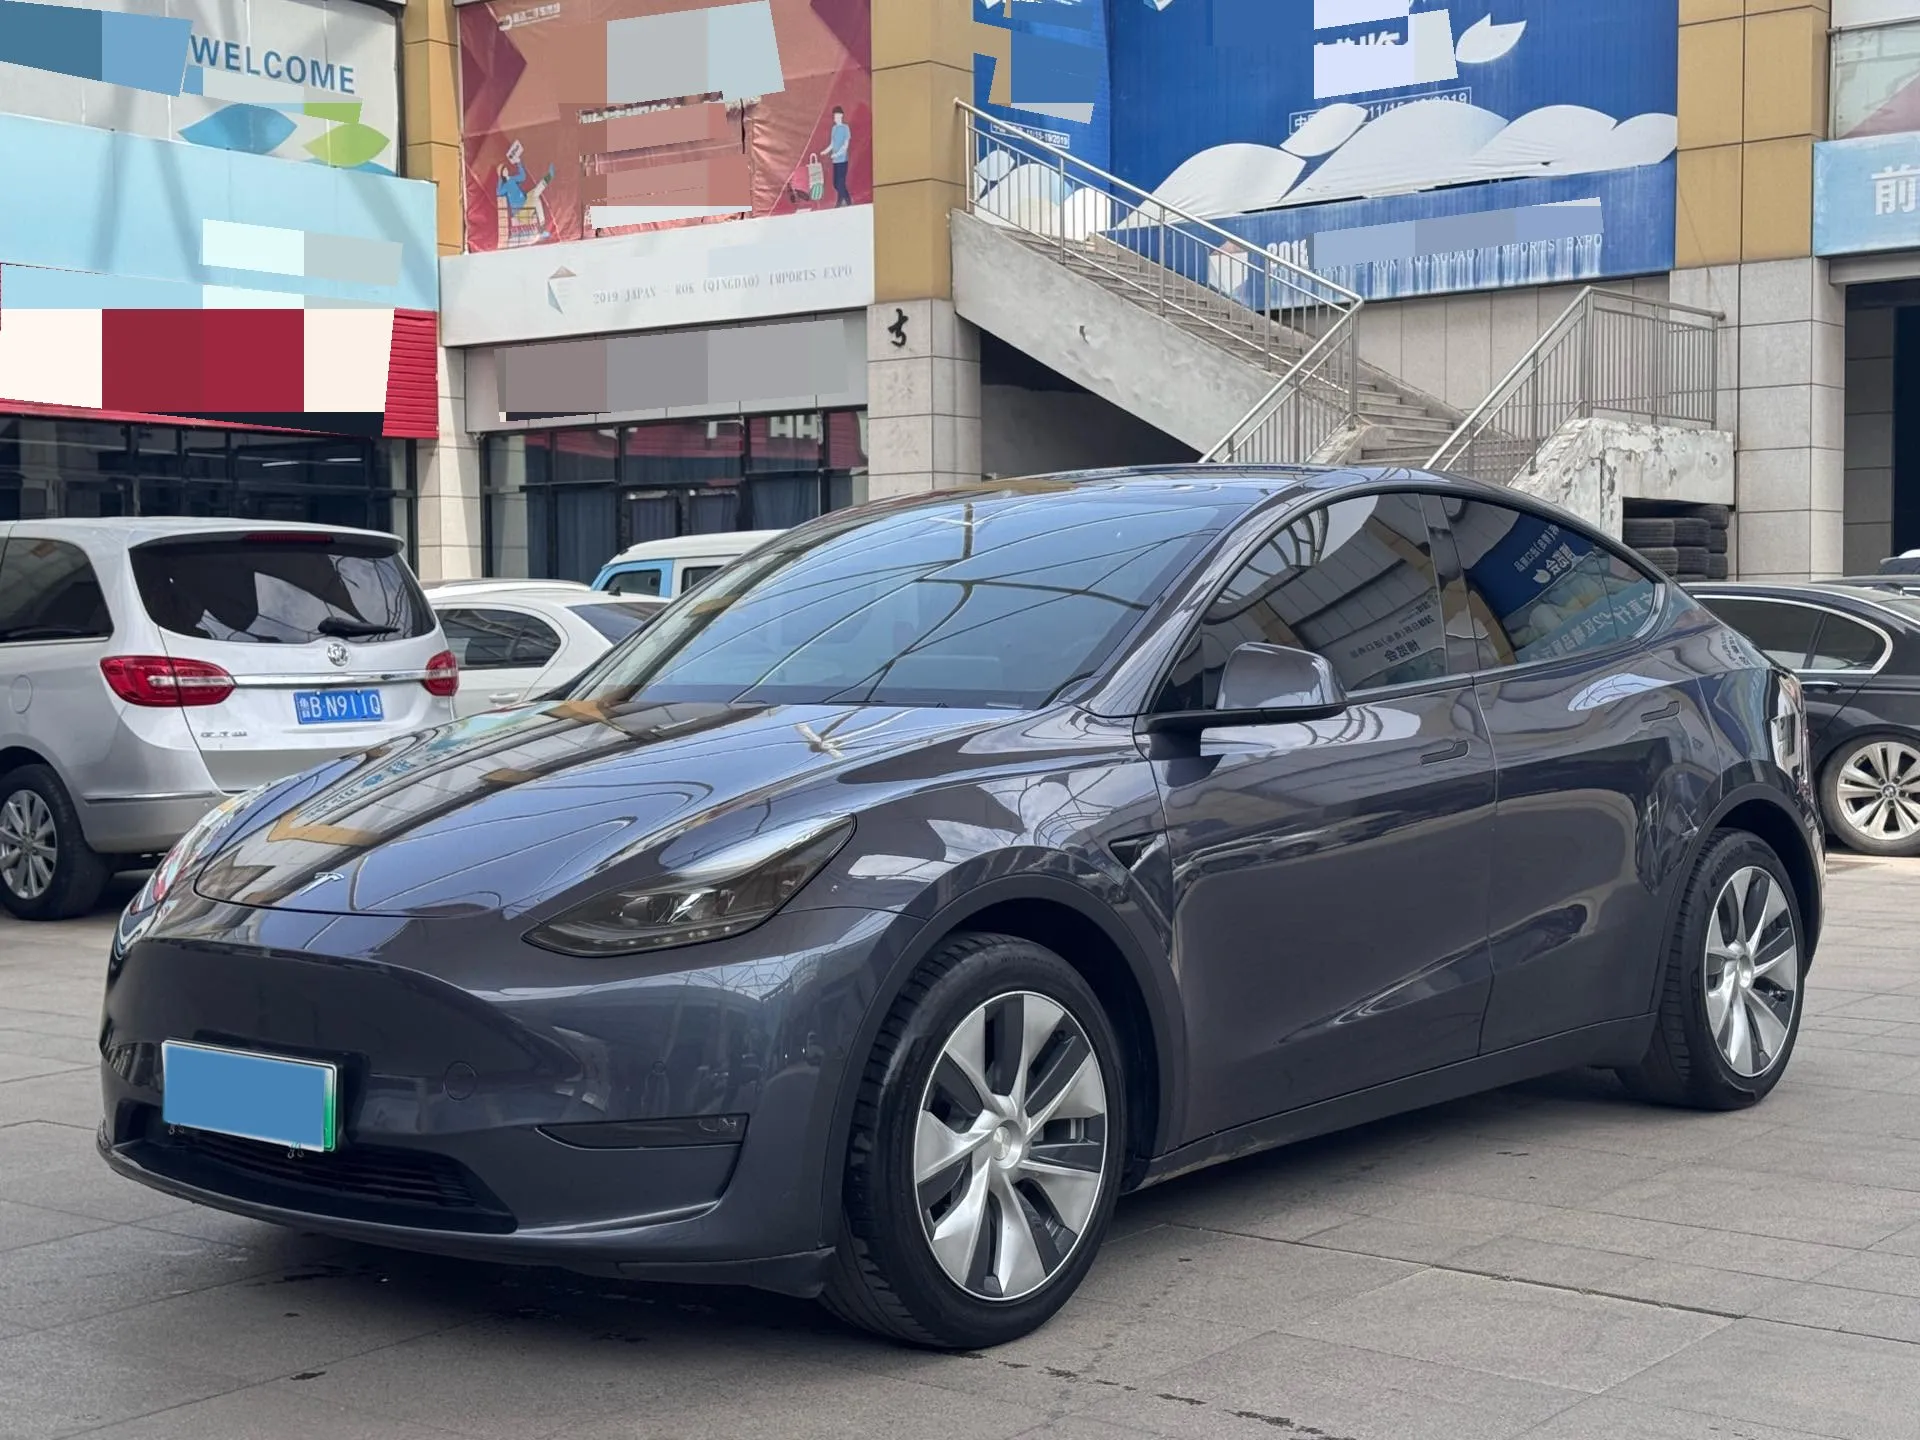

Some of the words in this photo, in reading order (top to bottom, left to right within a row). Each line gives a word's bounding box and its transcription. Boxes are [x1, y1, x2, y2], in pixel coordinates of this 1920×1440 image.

[190, 34, 355, 94] WELCOME
[1871, 163, 1920, 215] 前
[592, 290, 619, 305] 2019
[624, 283, 657, 303] JAPAN
[768, 268, 817, 286] IMPORTS
[823, 263, 853, 280] EXPO
